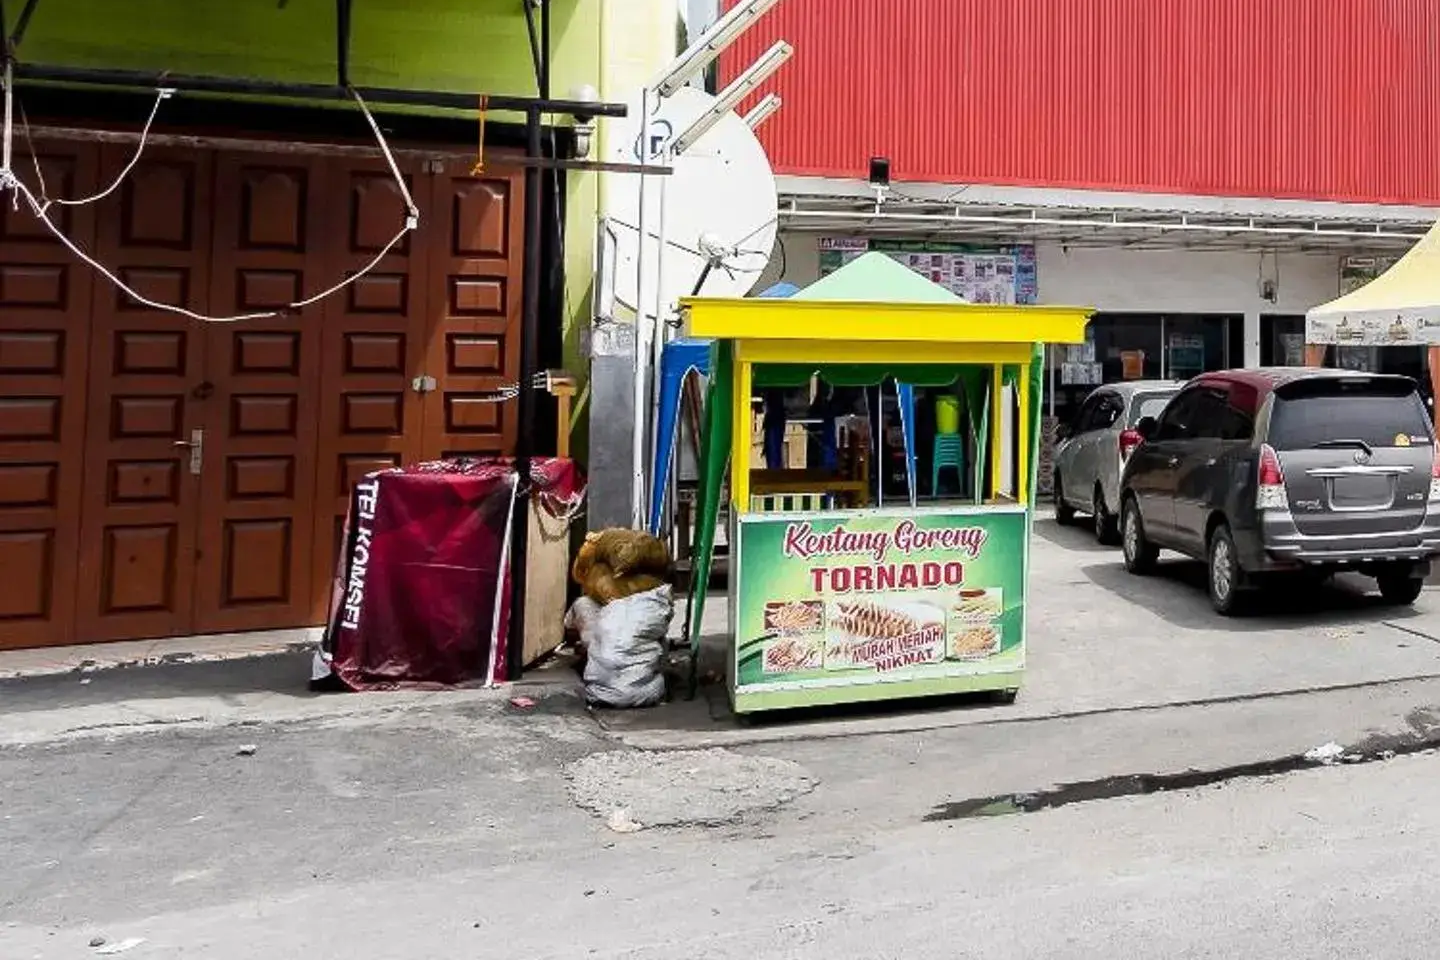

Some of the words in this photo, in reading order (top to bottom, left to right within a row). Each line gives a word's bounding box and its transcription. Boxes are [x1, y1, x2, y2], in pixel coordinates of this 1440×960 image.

[784, 522, 889, 563] Kentang
[893, 520, 986, 557] Goreng
[811, 562, 964, 593] TORNADO
[875, 648, 934, 672] NIKMAT
